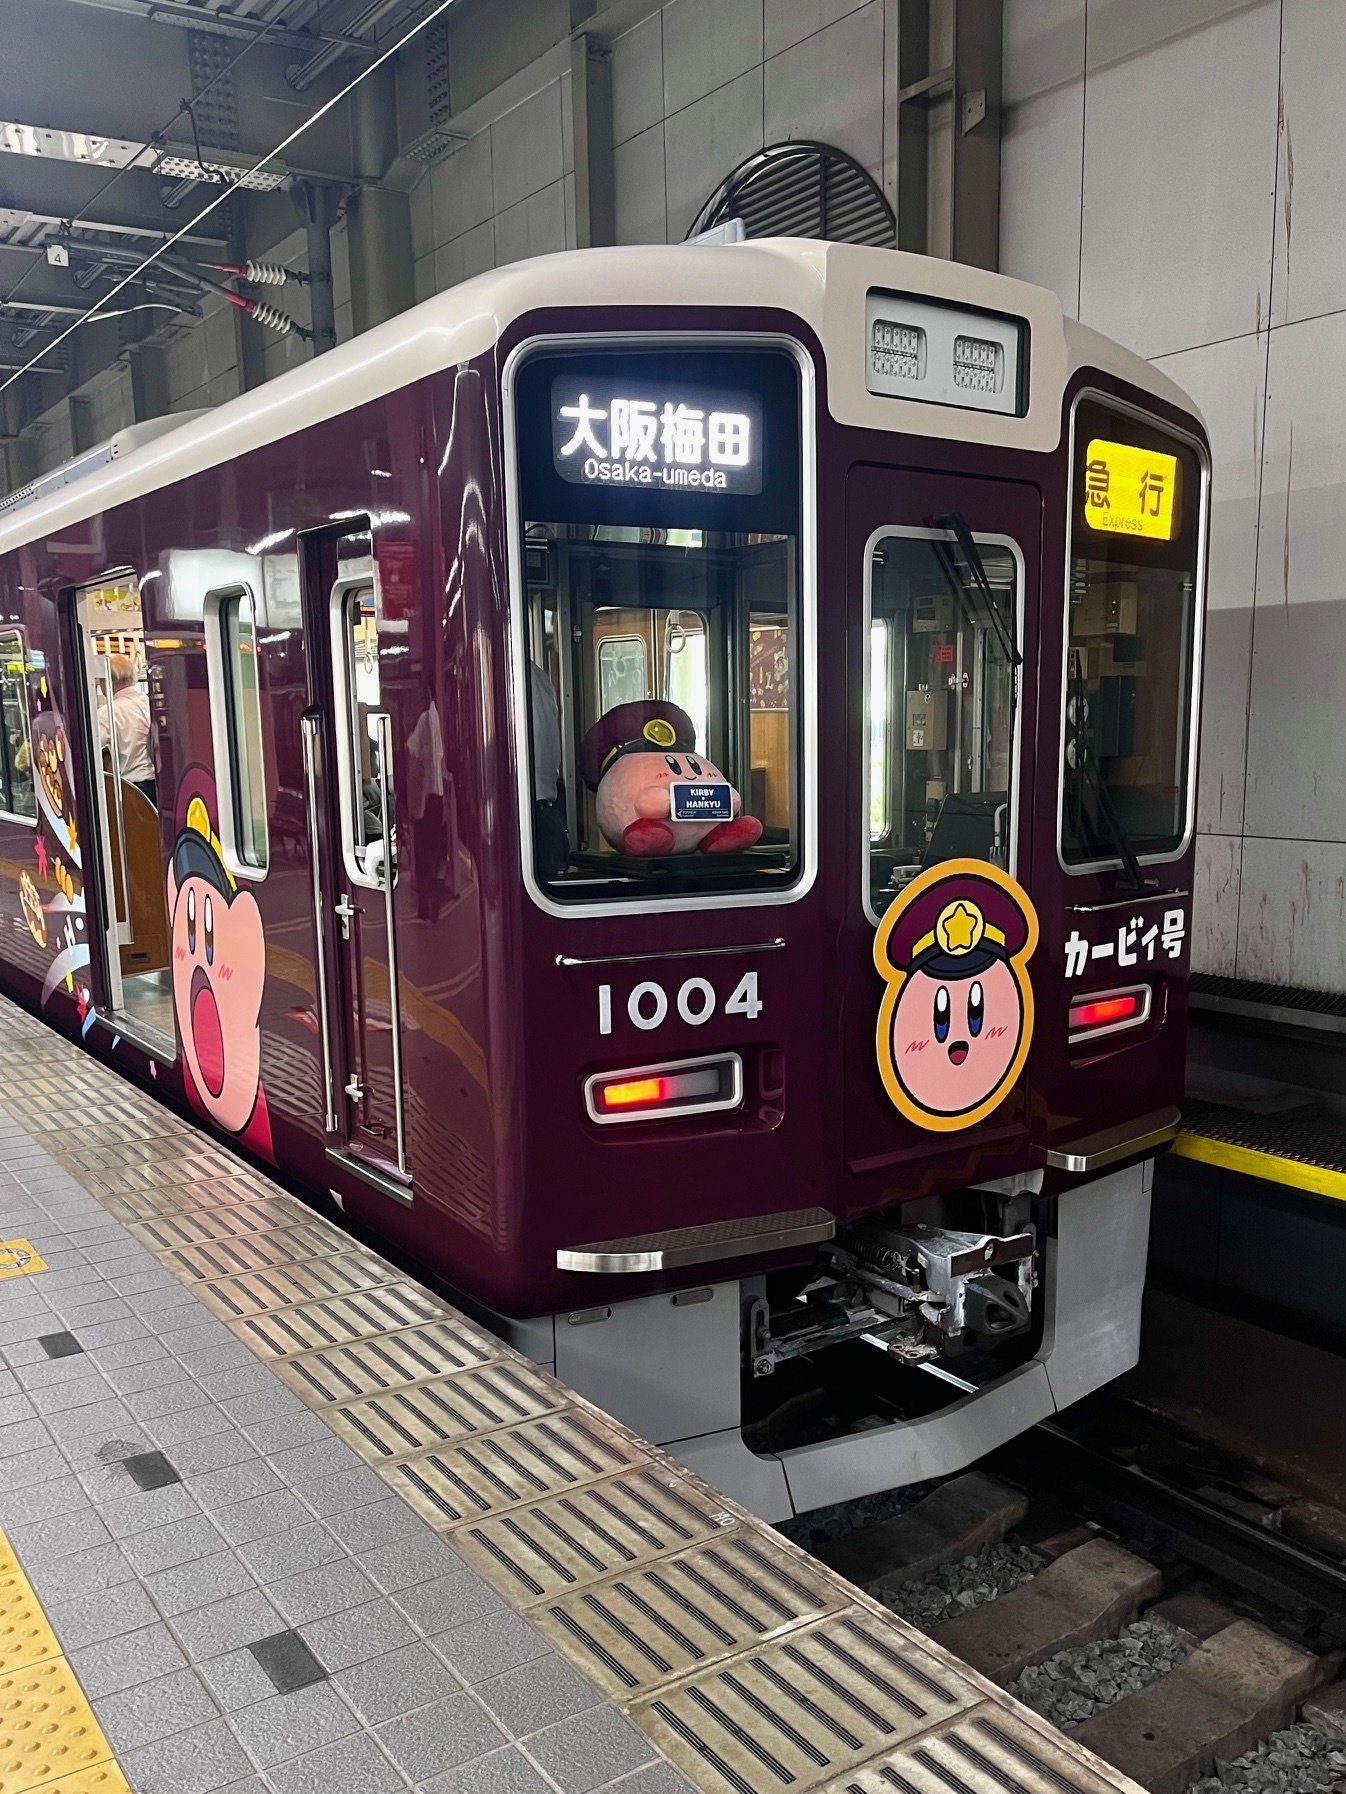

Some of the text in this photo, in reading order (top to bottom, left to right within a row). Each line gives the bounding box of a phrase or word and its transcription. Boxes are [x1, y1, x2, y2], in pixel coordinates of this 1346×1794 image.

[54, 253, 62, 263] 4
[559, 394, 750, 466] 大阪梅田
[584, 457, 728, 488] Osaka-umeda
[1086, 459, 1167, 517] 急行
[1102, 511, 1144, 531] Express
[686, 800, 721, 808] HANKYU
[690, 788, 715, 797] KIRBY
[1064, 908, 1185, 978] カービィ号
[598, 971, 763, 1035] 1004
